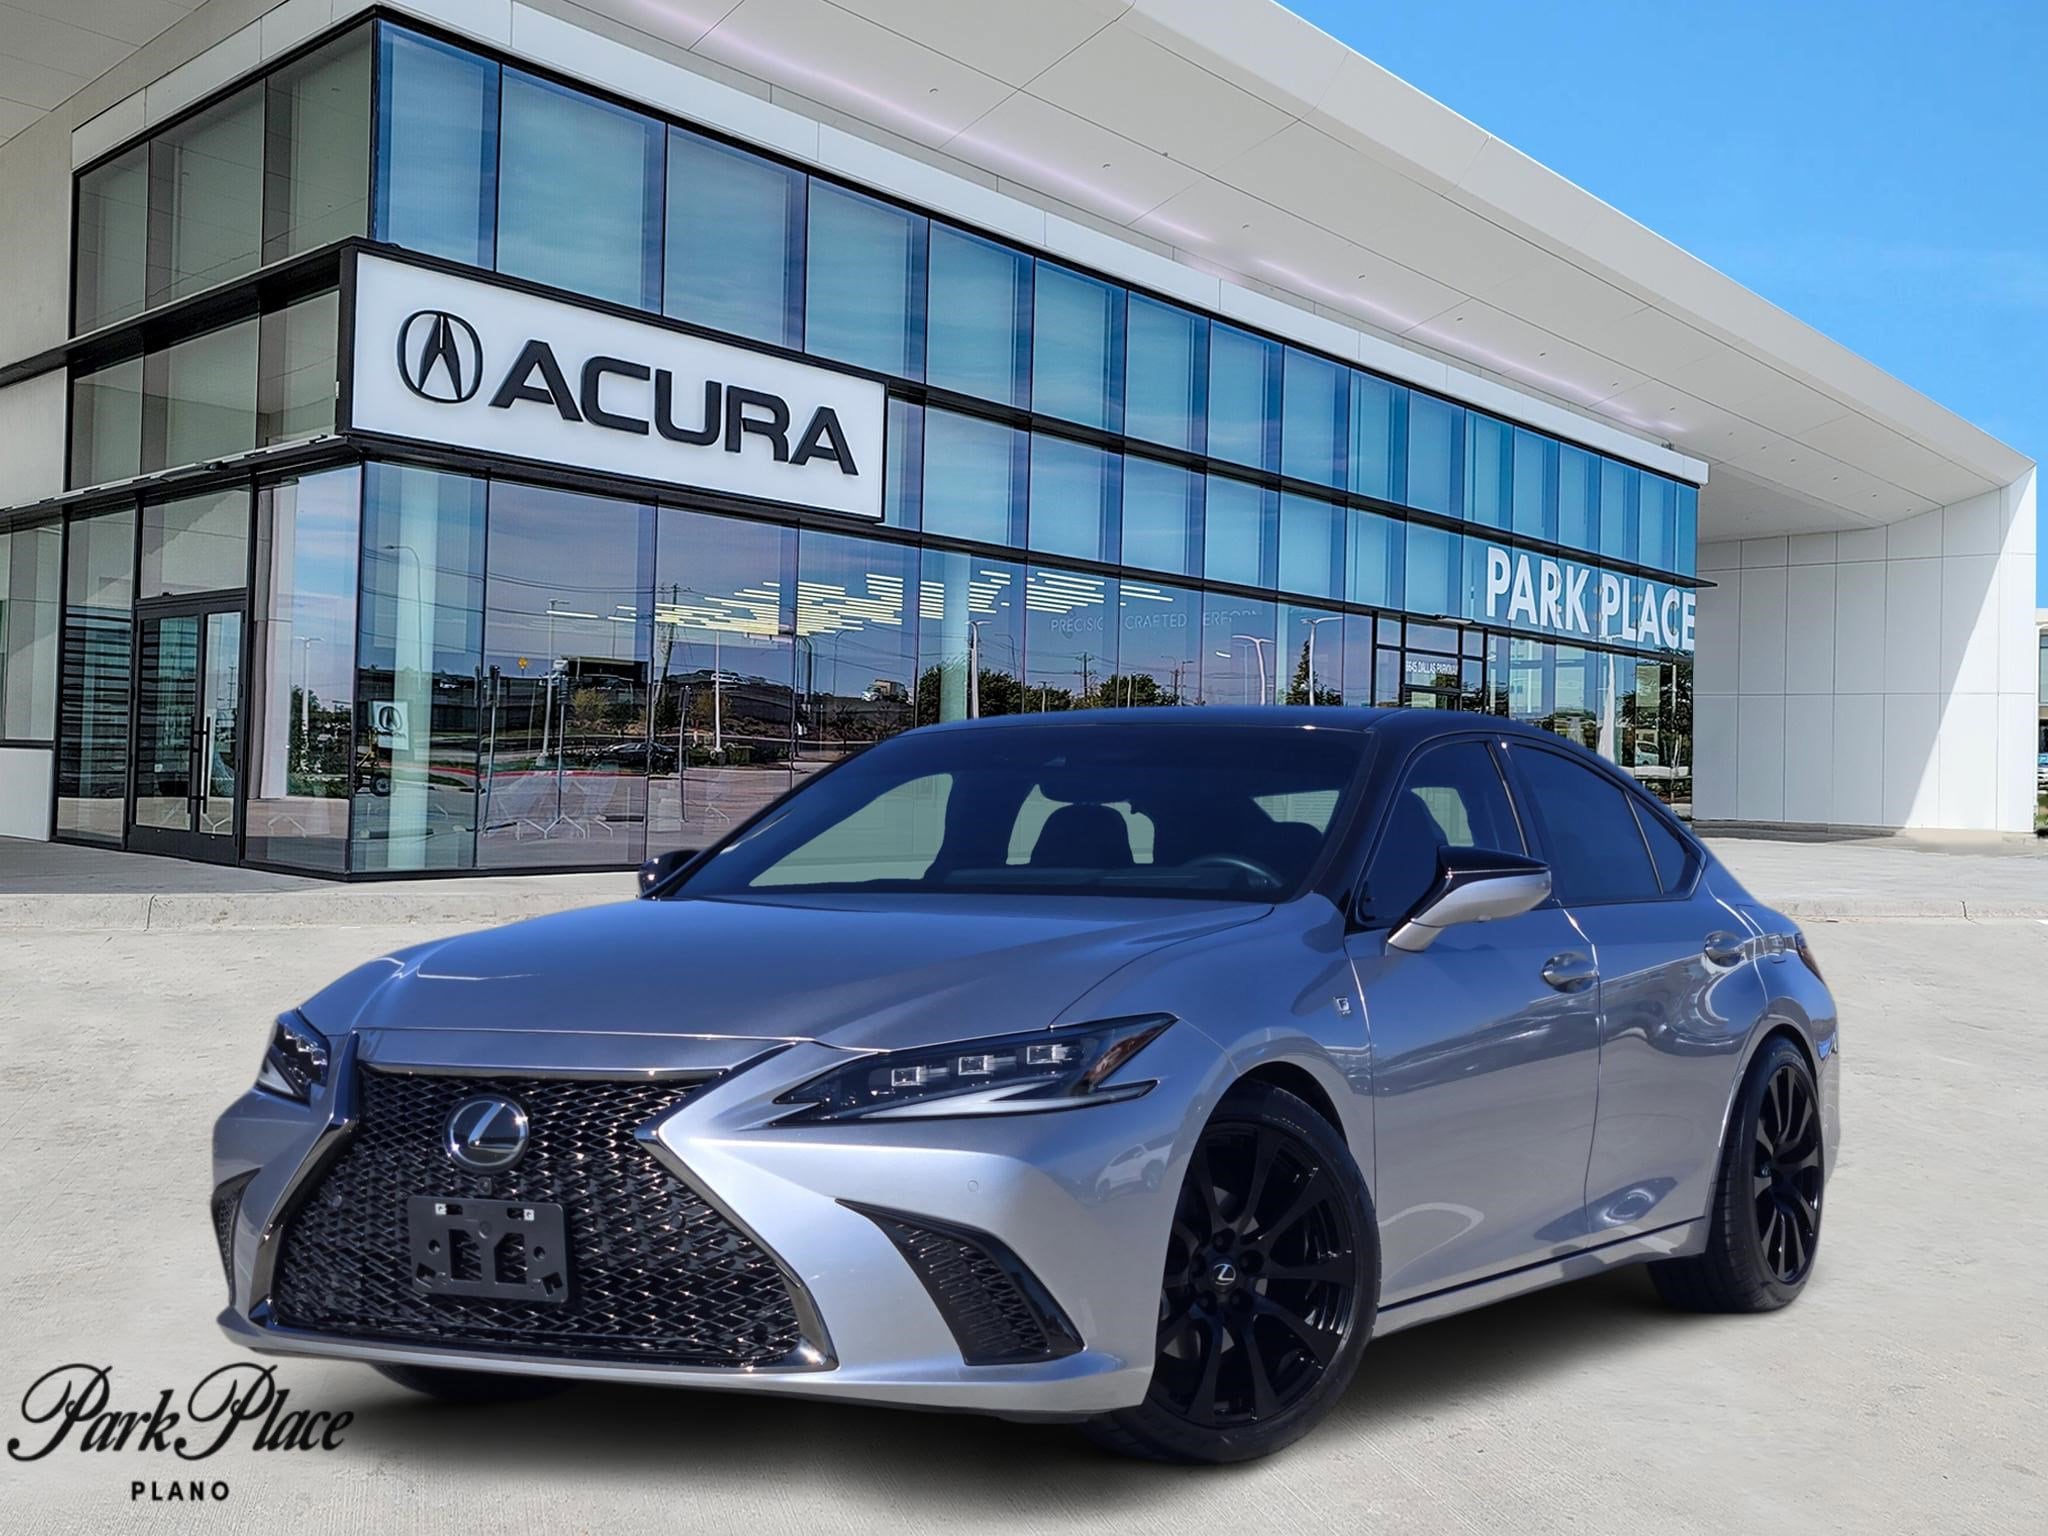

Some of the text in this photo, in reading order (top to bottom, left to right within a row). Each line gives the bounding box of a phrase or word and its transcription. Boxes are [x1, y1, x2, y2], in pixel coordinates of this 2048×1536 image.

[488, 338, 860, 476] ACURA
[1486, 546, 1697, 651] PARK PLACE
